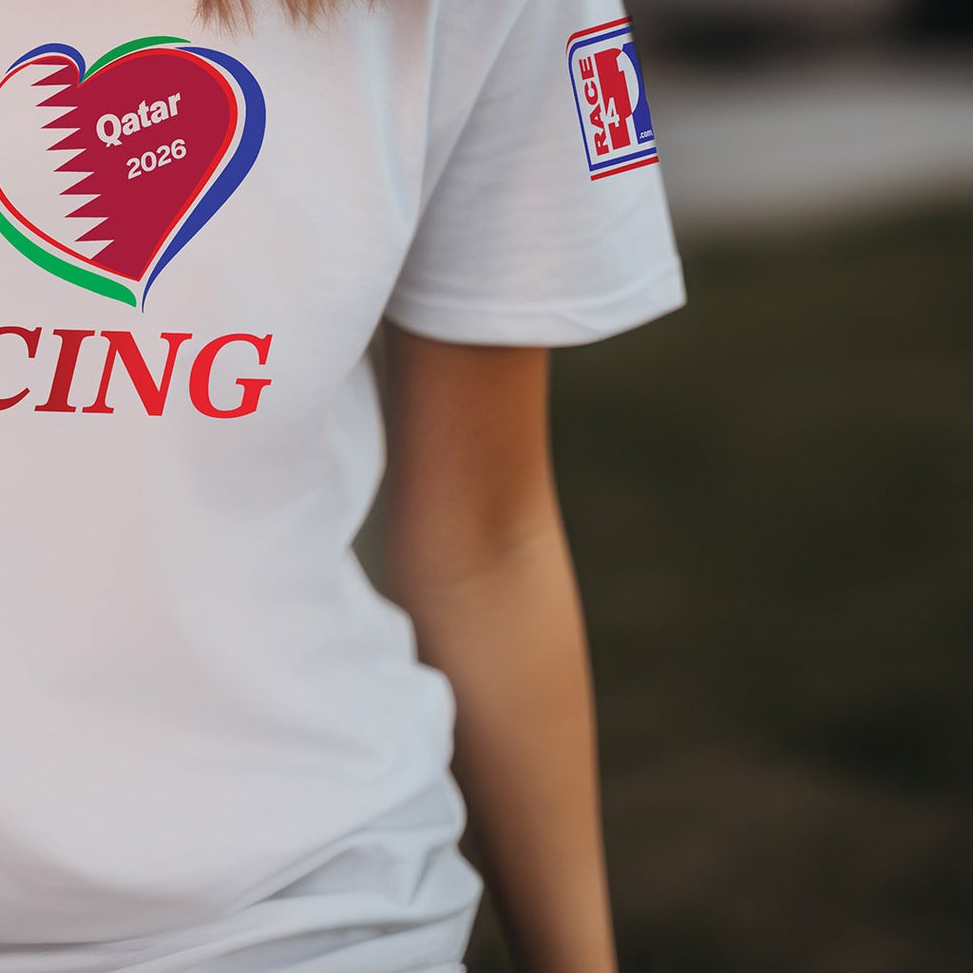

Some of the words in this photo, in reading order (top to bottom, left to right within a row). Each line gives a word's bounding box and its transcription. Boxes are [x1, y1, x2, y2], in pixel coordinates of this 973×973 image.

[96, 92, 181, 148] Qatar
[578, 56, 610, 156] RACE
[126, 138, 187, 180] 2026
